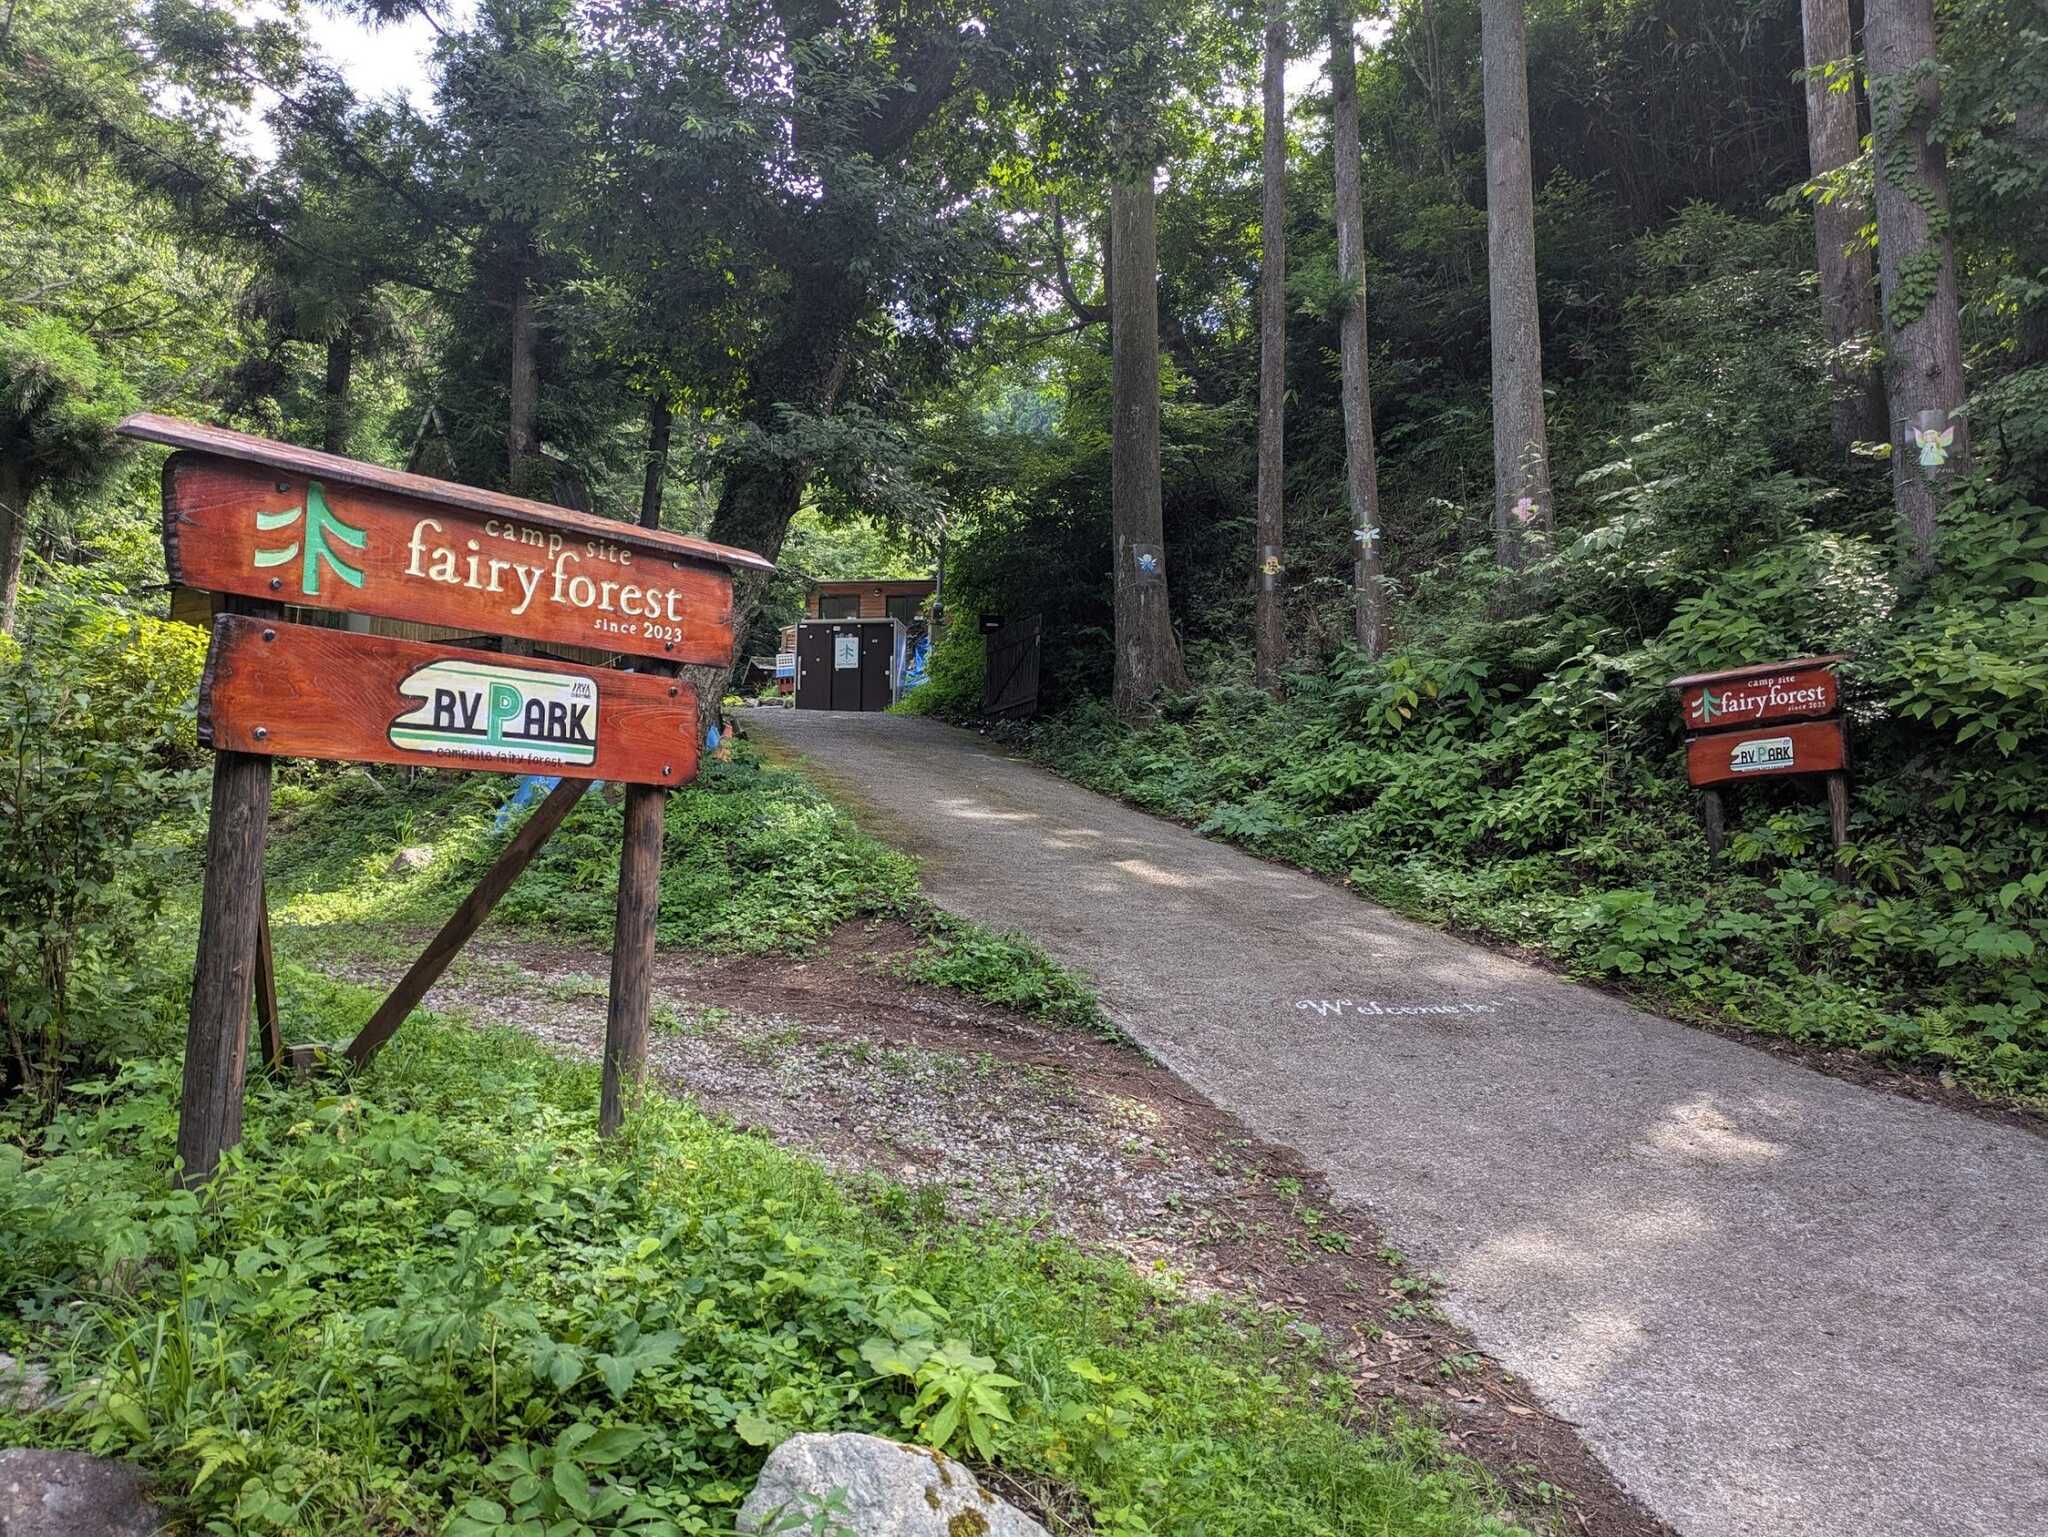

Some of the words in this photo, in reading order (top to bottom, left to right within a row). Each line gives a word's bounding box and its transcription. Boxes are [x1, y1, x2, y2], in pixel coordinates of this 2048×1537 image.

[485, 520, 562, 560] camp
[586, 540, 632, 565] site
[594, 618, 637, 635] since
[643, 621, 682, 642] 2023
[1748, 677, 1774, 688] camp
[1778, 675, 1795, 684] site
